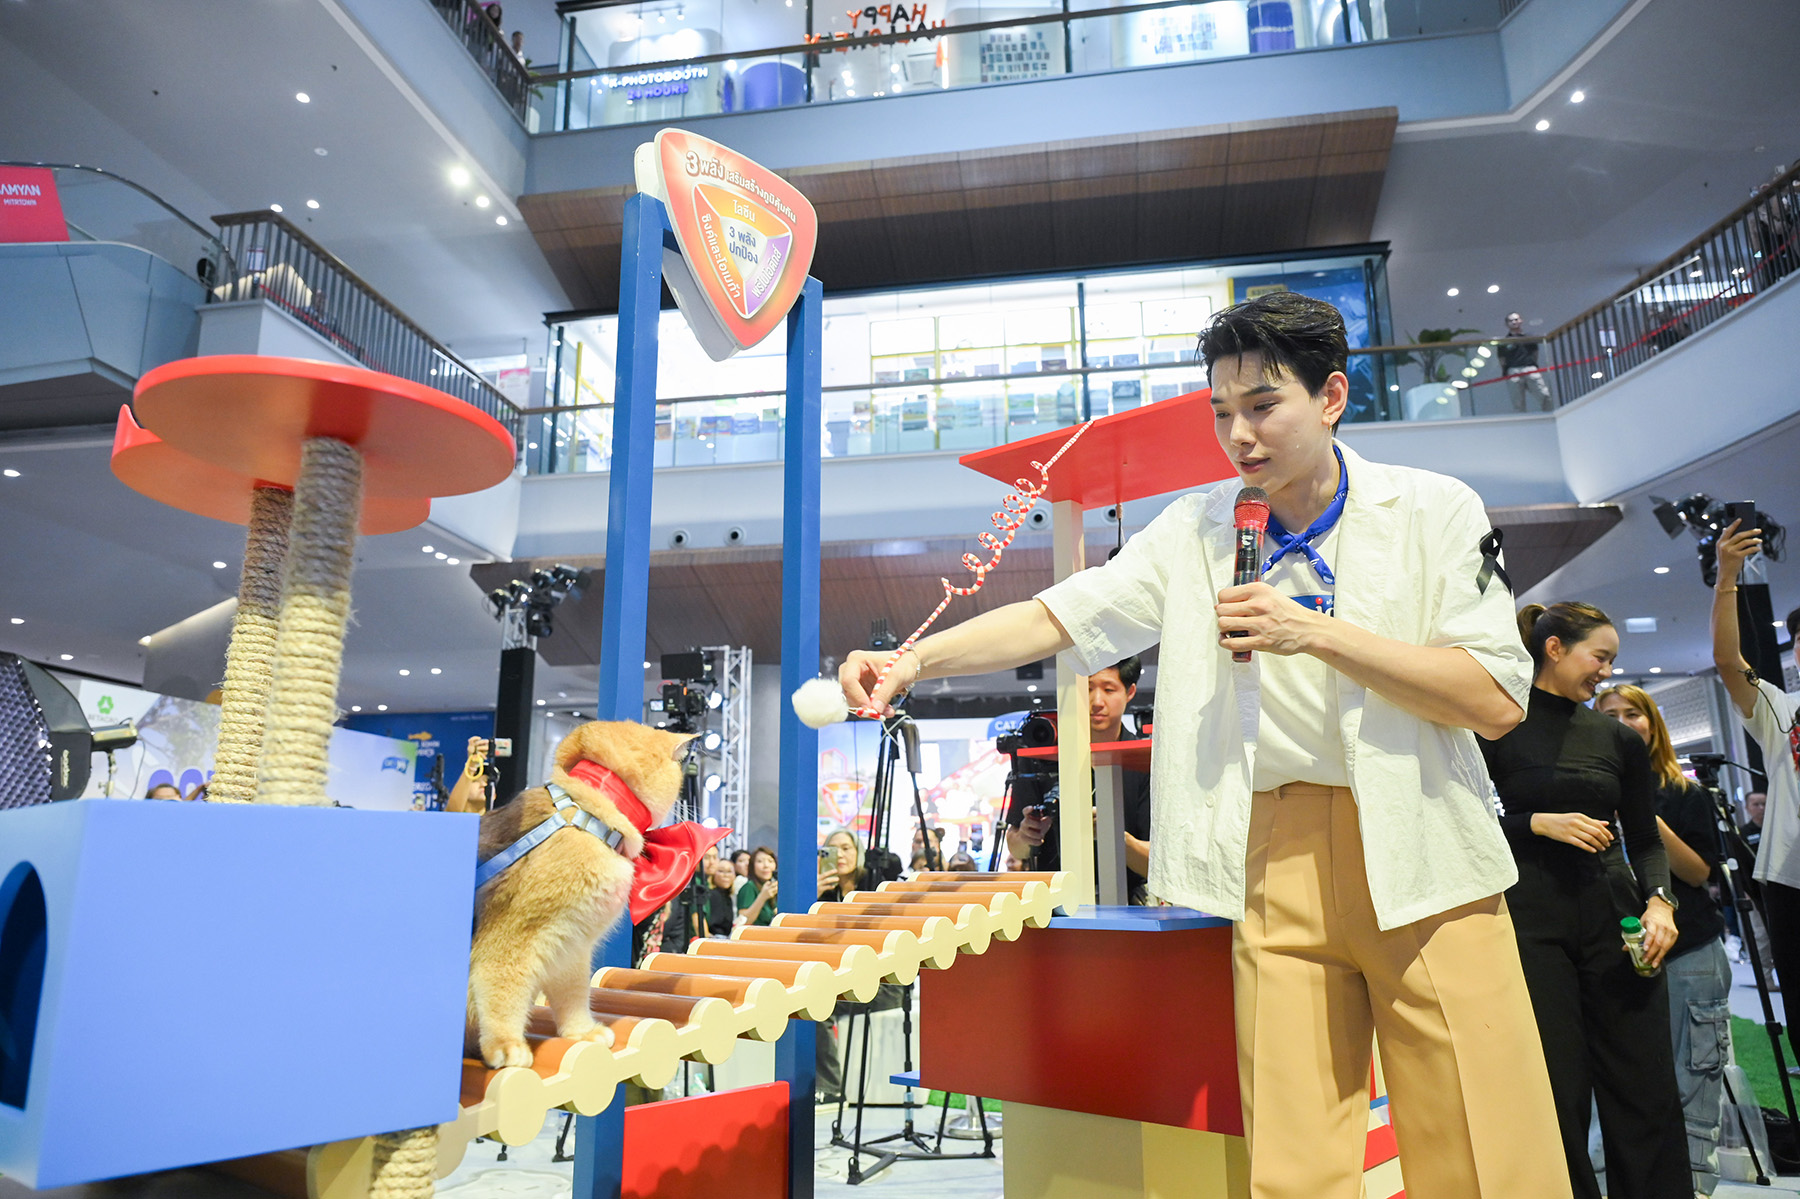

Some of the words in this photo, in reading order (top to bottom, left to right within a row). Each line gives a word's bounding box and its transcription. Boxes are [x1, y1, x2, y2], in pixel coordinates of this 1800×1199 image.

[609, 67, 708, 88] K-PHOTOBOOTH
[645, 83, 689, 98] HOURS
[0, 184, 41, 196] AMYAN
[729, 226, 736, 238] 3
[738, 231, 757, 248] พลัง
[729, 241, 759, 264] ปกป้อง
[994, 720, 1016, 731] CAT
